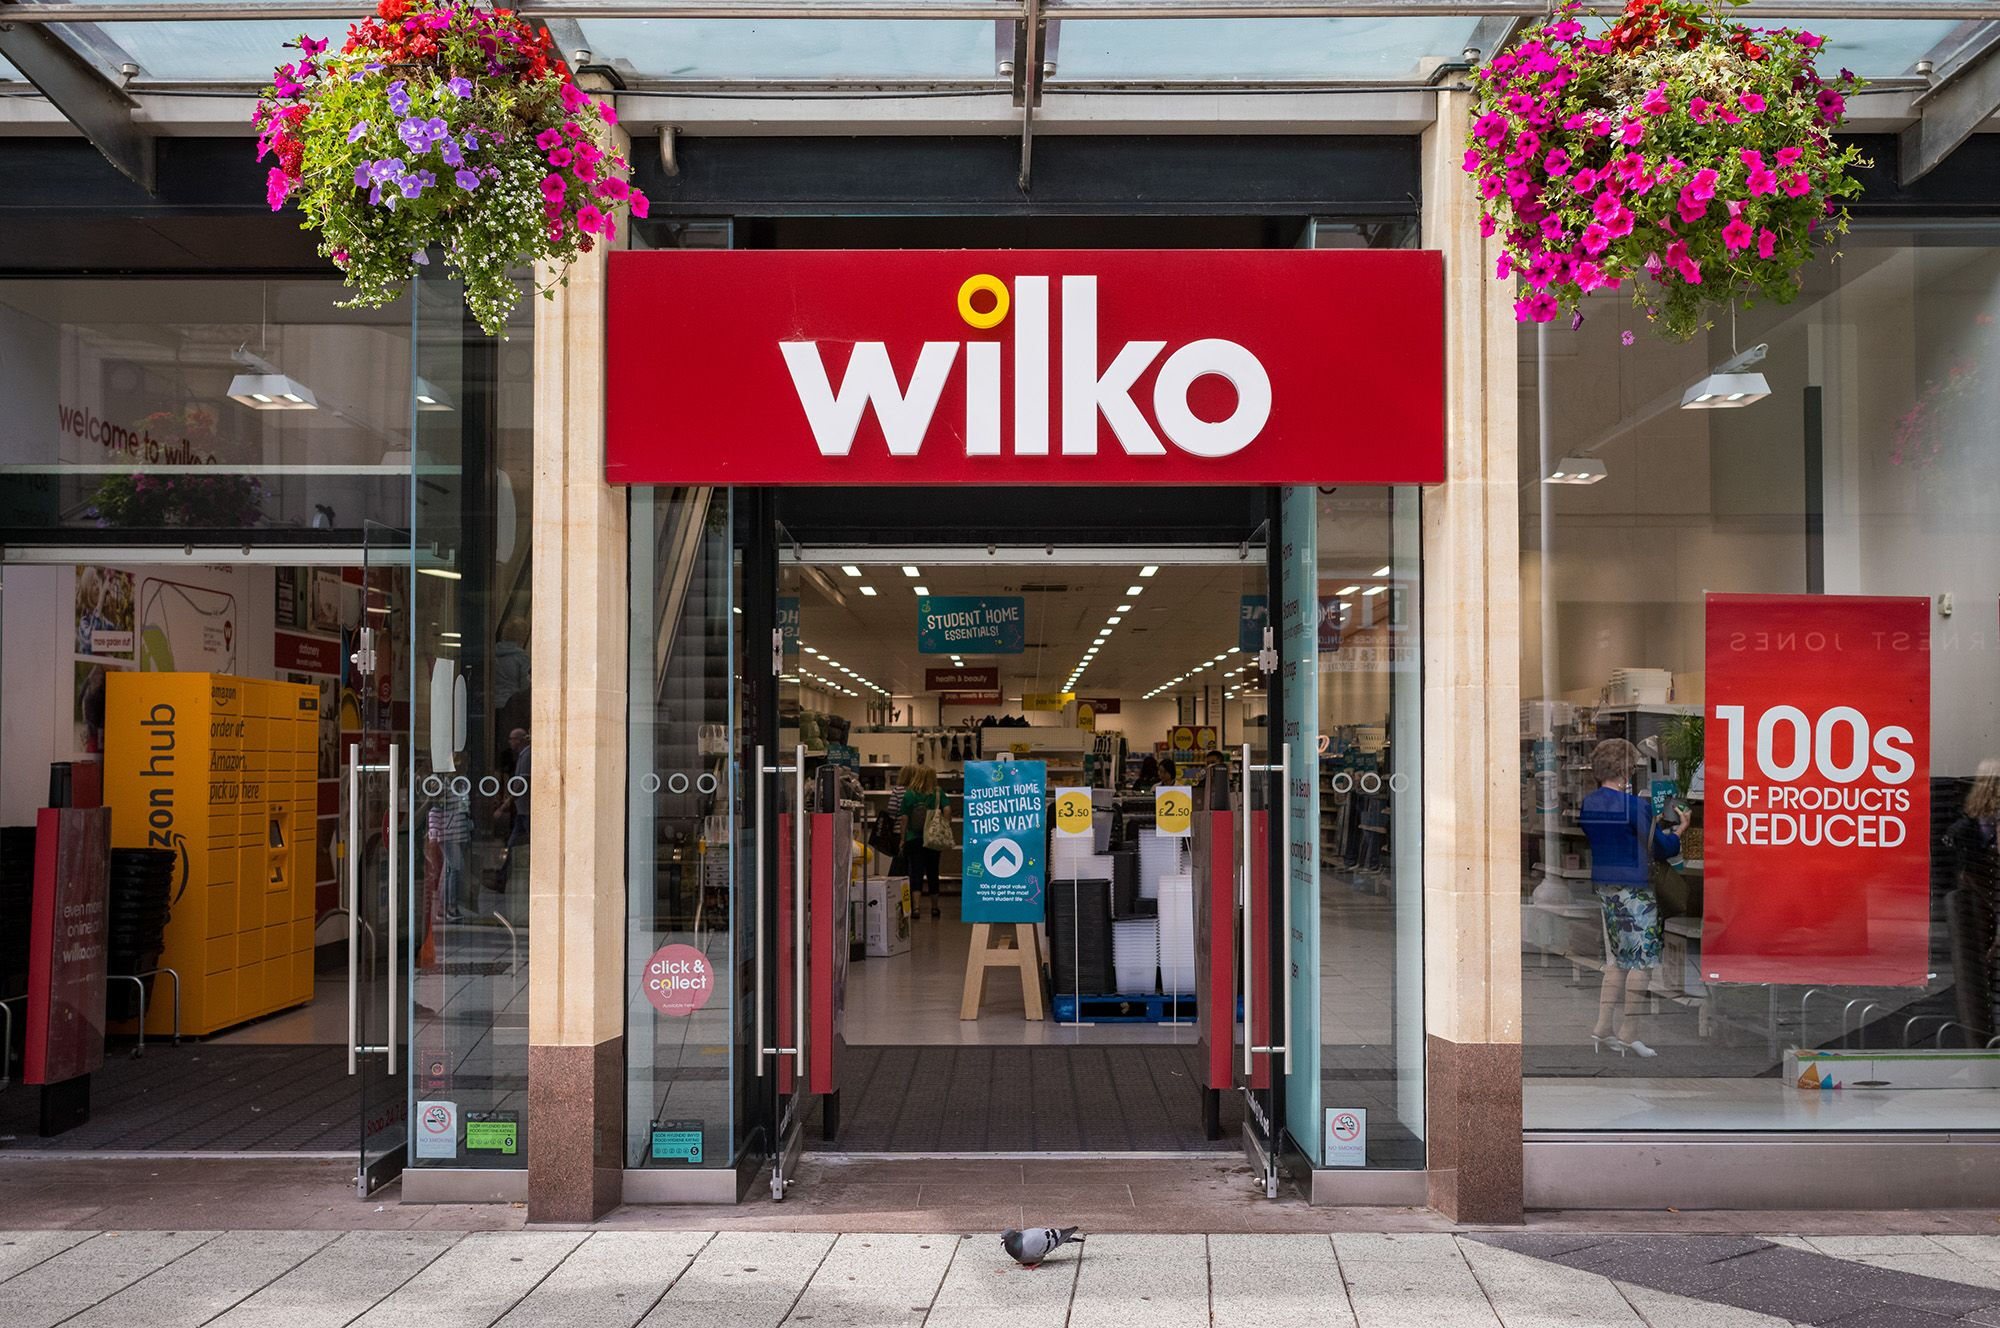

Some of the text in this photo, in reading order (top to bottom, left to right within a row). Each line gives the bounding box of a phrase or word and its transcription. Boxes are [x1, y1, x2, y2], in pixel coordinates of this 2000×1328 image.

[778, 273, 1273, 458] wilko
[58, 404, 139, 456] welcome
[144, 430, 159, 465] to
[927, 607, 1019, 630] STUDENT HOME
[945, 626, 999, 641] ESSENTIALS!
[936, 674, 956, 682] health
[964, 675, 987, 683] beauty
[211, 686, 236, 700] amazon
[210, 718, 234, 738] order
[1716, 704, 1916, 784] 100s
[139, 704, 176, 848] zon hub
[209, 780, 260, 804] pick up here
[970, 783, 1040, 800] STUDENT HOME
[1724, 785, 1910, 812] OF PRODUCTS
[968, 797, 1042, 816] ESSENTIALS
[1058, 802, 1088, 818] £3.50
[1158, 800, 1190, 817] £2.50
[972, 814, 1040, 834] THIS WAY!
[1726, 812, 1907, 848] REDUCED
[64, 904, 84, 918] even
[651, 960, 704, 974] click &
[650, 975, 706, 990] collect
